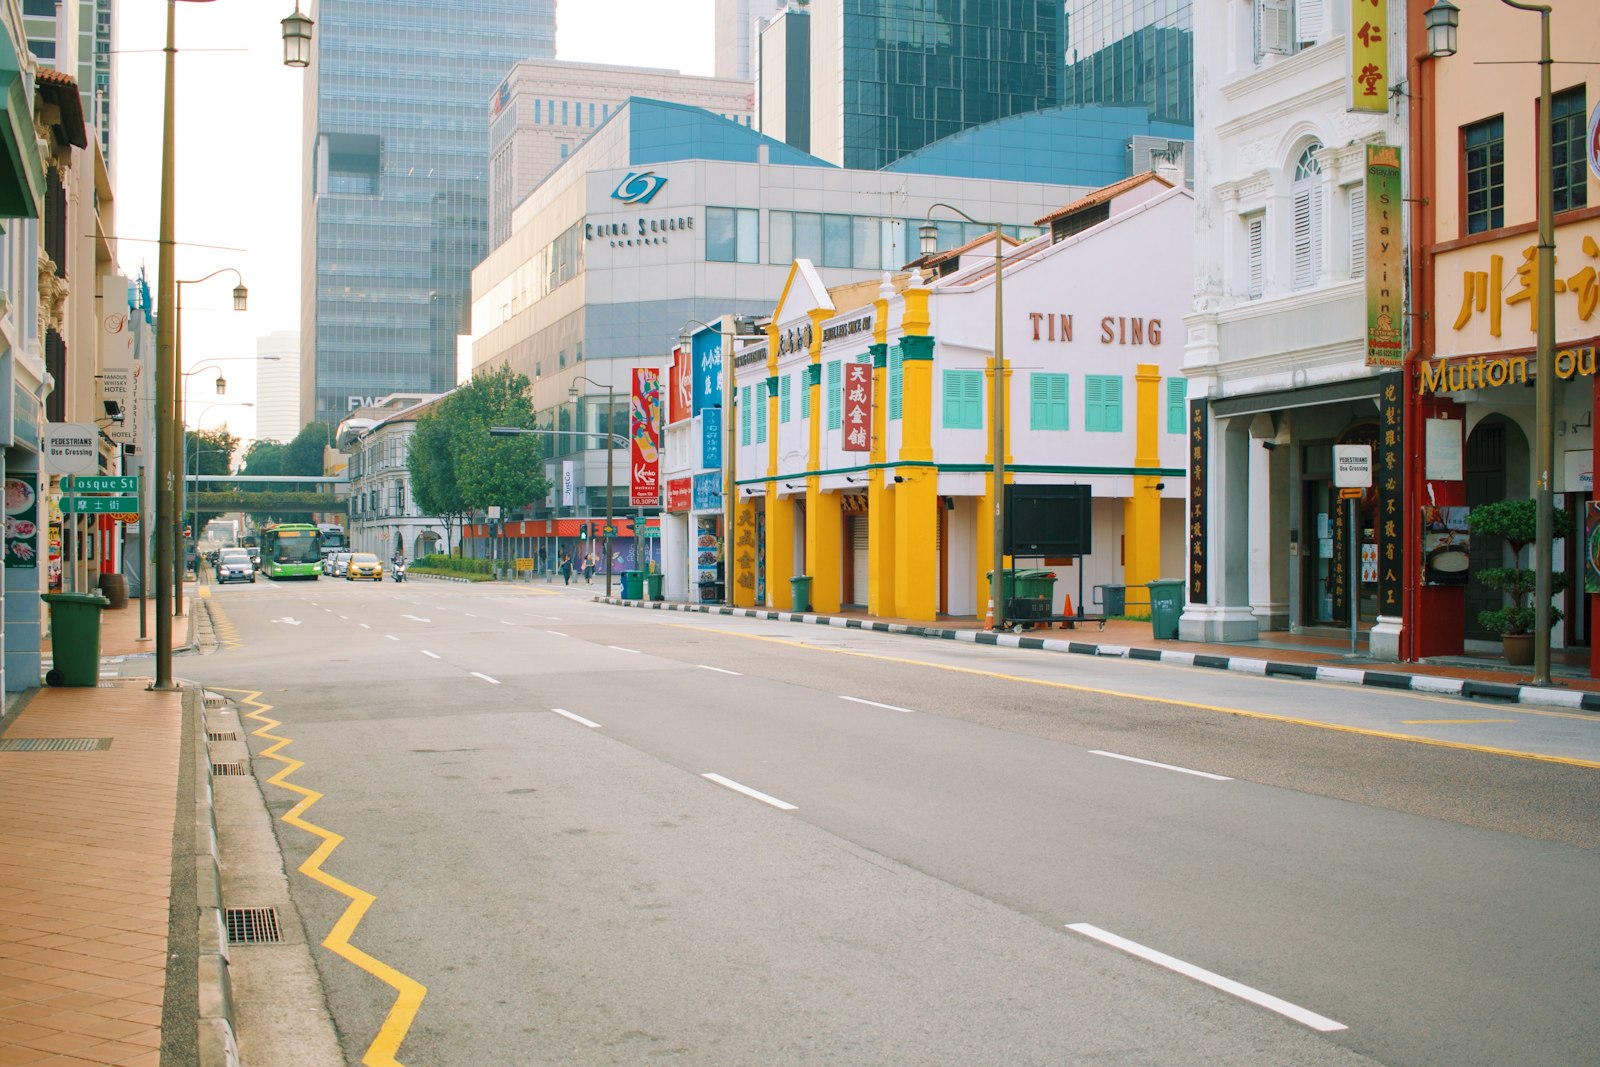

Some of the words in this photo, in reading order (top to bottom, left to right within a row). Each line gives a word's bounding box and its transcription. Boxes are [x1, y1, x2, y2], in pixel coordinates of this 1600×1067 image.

[1029, 312, 1073, 342] TIN
[1101, 315, 1162, 346] SING
[1367, 357, 1377, 365] 24
[1379, 357, 1402, 366] Hours
[1418, 356, 1527, 396] Mutton
[1349, 465, 1369, 473] Crossing
[66, 479, 116, 490] osque
[120, 478, 134, 489] St
[77, 500, 120, 511] 摩士街
